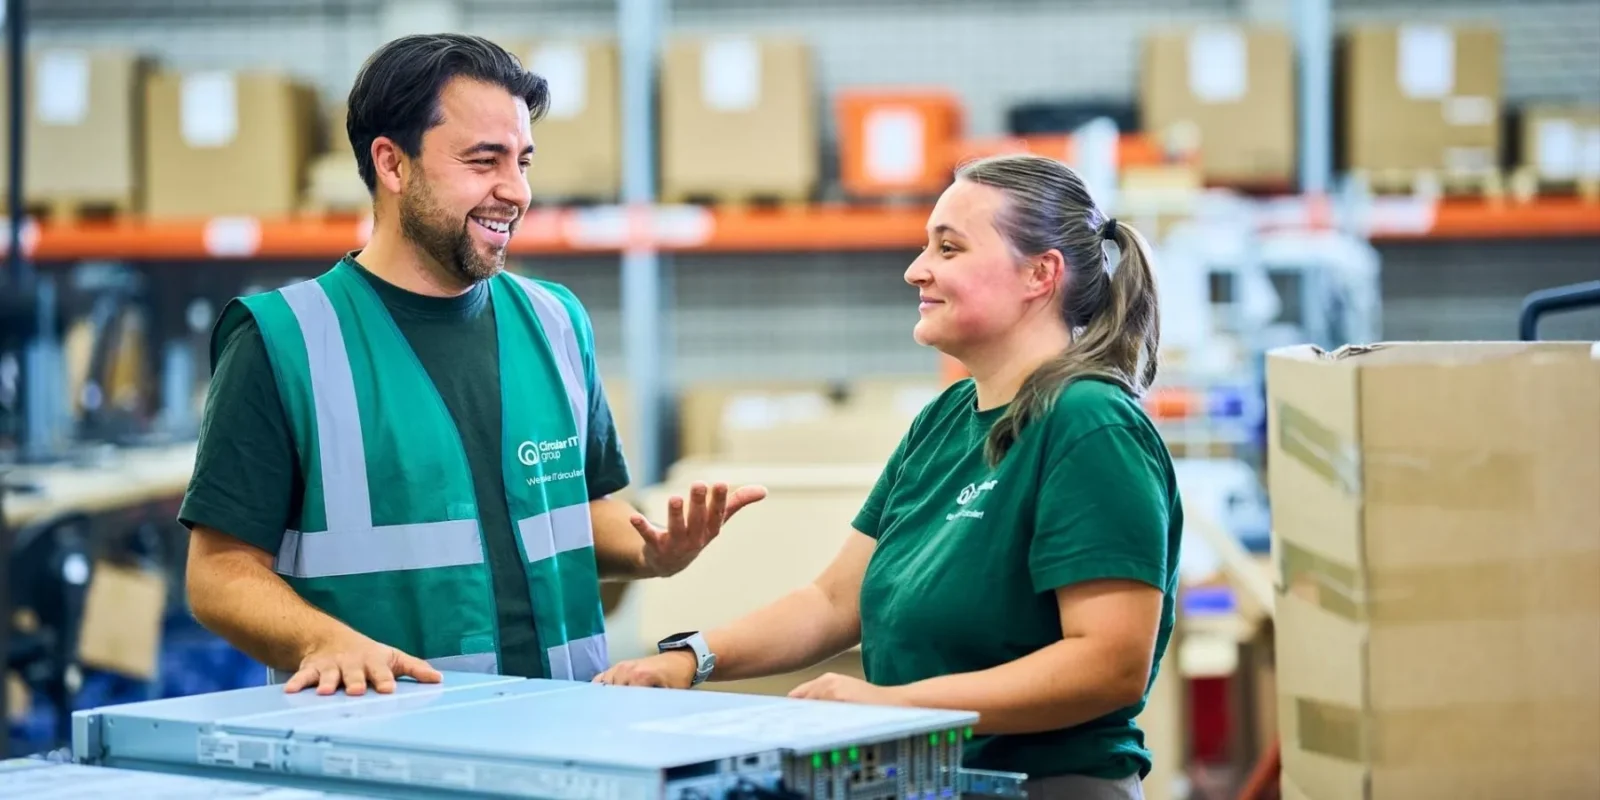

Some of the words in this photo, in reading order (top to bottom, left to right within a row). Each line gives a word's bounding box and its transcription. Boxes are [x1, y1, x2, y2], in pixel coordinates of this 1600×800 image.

[539, 440, 567, 451] Circular
[568, 436, 578, 447] IT
[541, 451, 561, 462] group
